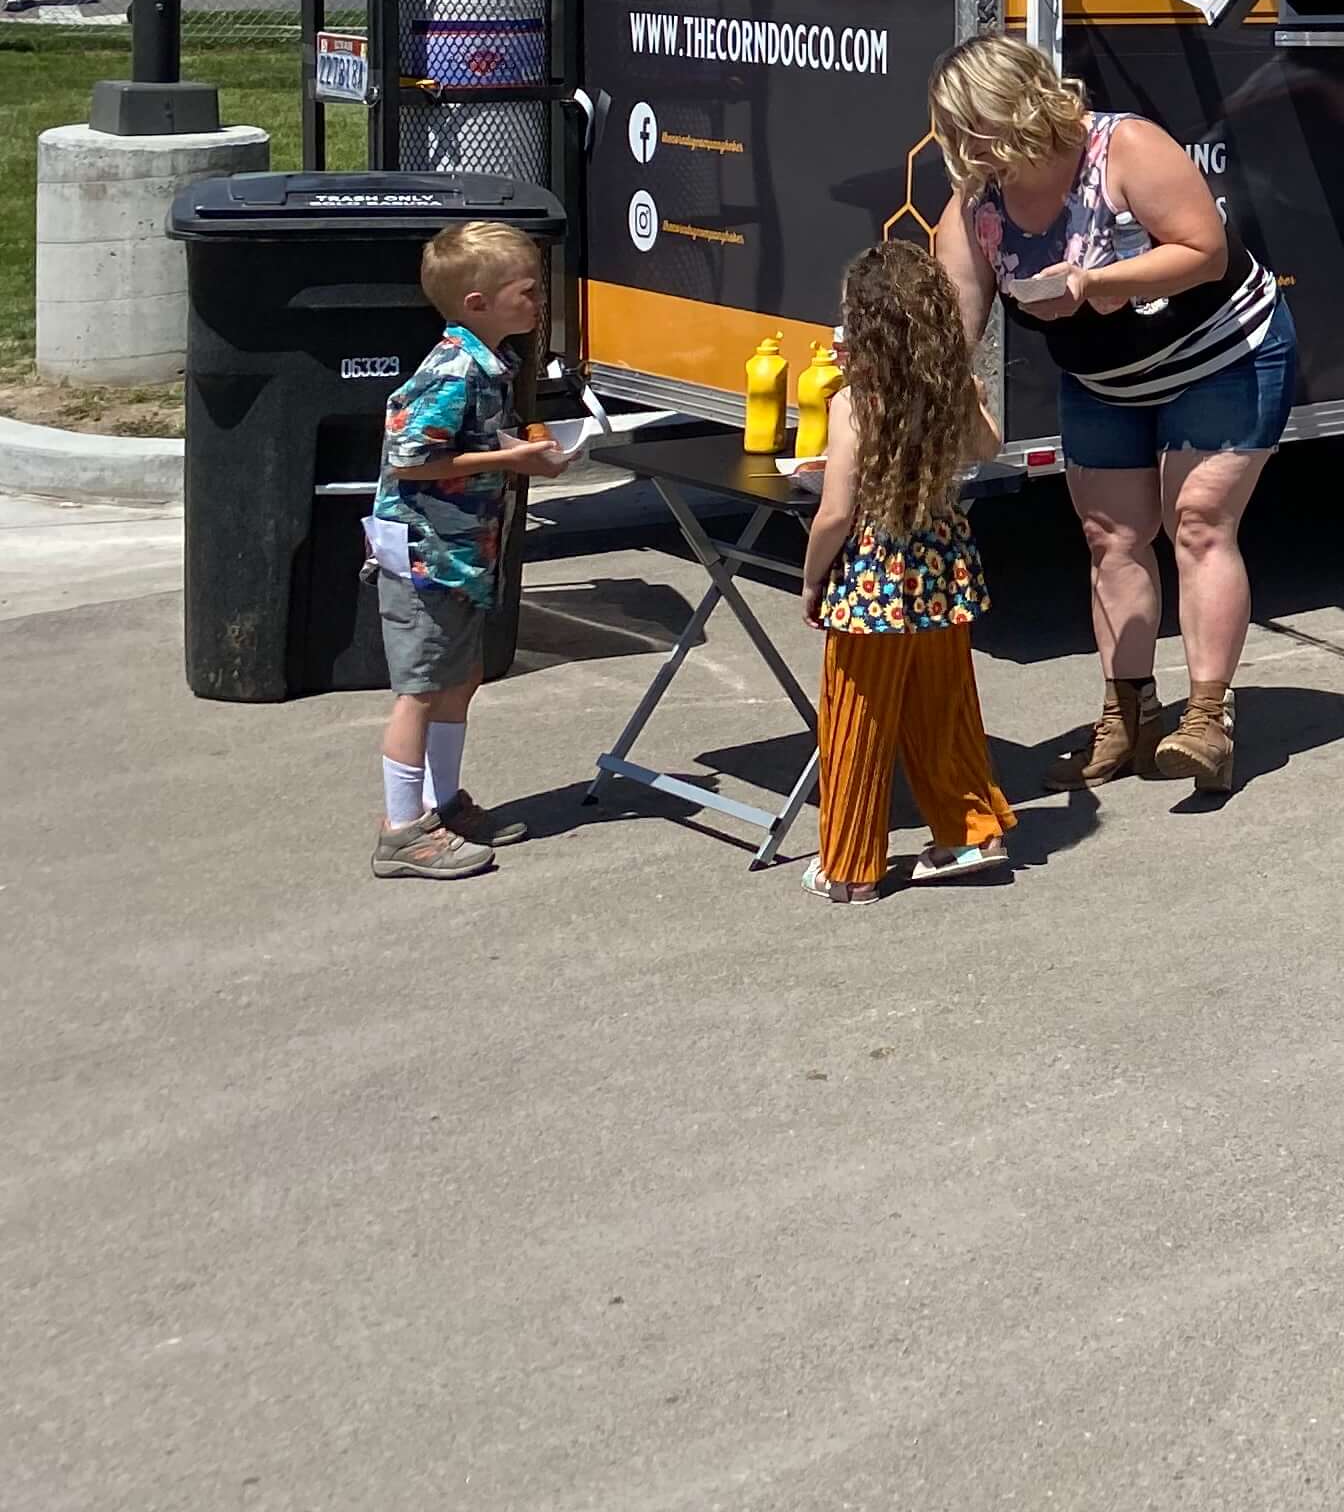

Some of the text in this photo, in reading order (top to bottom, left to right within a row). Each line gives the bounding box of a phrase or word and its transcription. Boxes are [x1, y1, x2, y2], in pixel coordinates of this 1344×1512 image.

[629, 11, 888, 75] WWW.THECORNDOGCO.COM
[315, 194, 434, 202] TRASH ONLY
